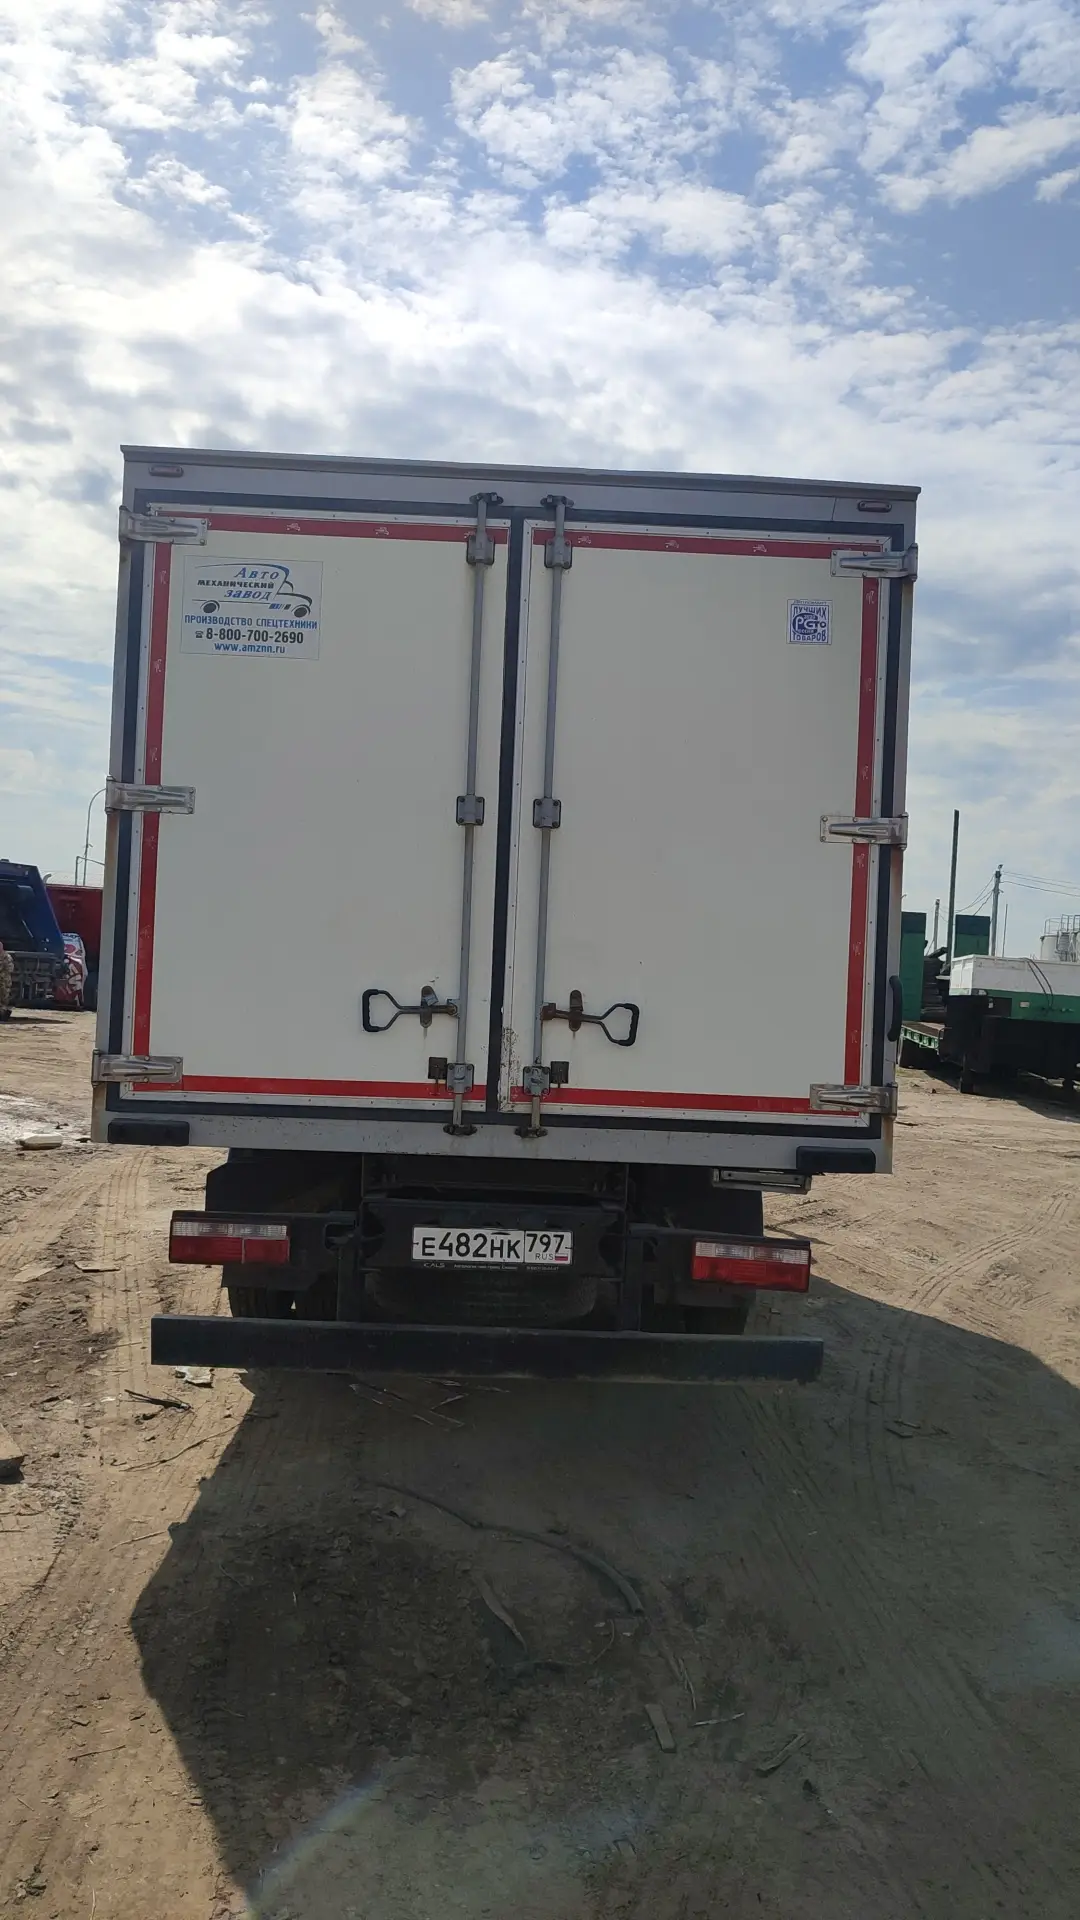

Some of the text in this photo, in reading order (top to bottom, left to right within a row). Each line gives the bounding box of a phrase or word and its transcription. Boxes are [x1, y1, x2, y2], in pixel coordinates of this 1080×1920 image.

[184, 615, 317, 629] ПРОИЗВОДСТВО СПЕЦТЕХНИКИ
[206, 628, 303, 643] 8-800-700-2690
[214, 643, 285, 653] www.amznn.ru
[527, 1233, 565, 1253] 797
